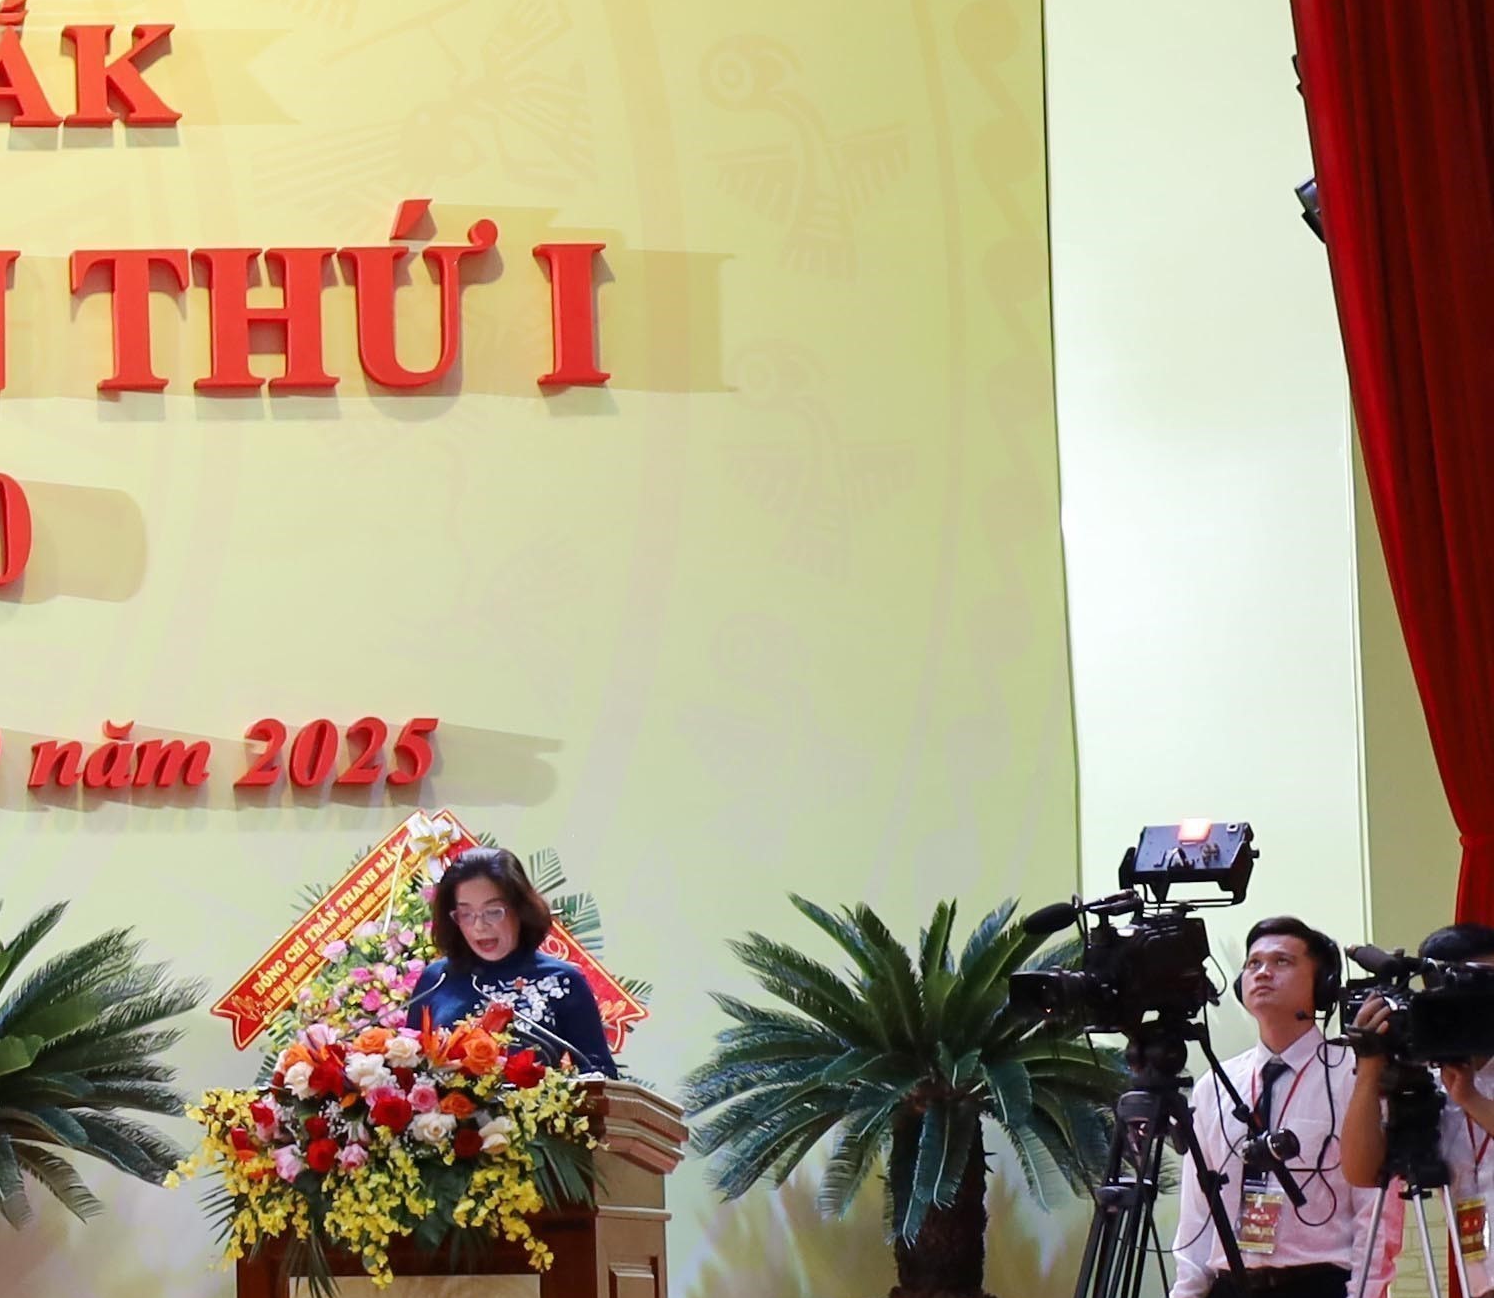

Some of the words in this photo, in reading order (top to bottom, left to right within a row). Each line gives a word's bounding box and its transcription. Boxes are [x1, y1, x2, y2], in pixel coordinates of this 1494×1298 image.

[72, 200, 497, 397] THỨ
[535, 244, 610, 388] I
[28, 721, 210, 796] năm
[237, 717, 438, 791] 2025
[249, 955, 288, 996] ĐỒNG
[282, 935, 308, 963] CHÍ
[335, 866, 379, 911] THANH
